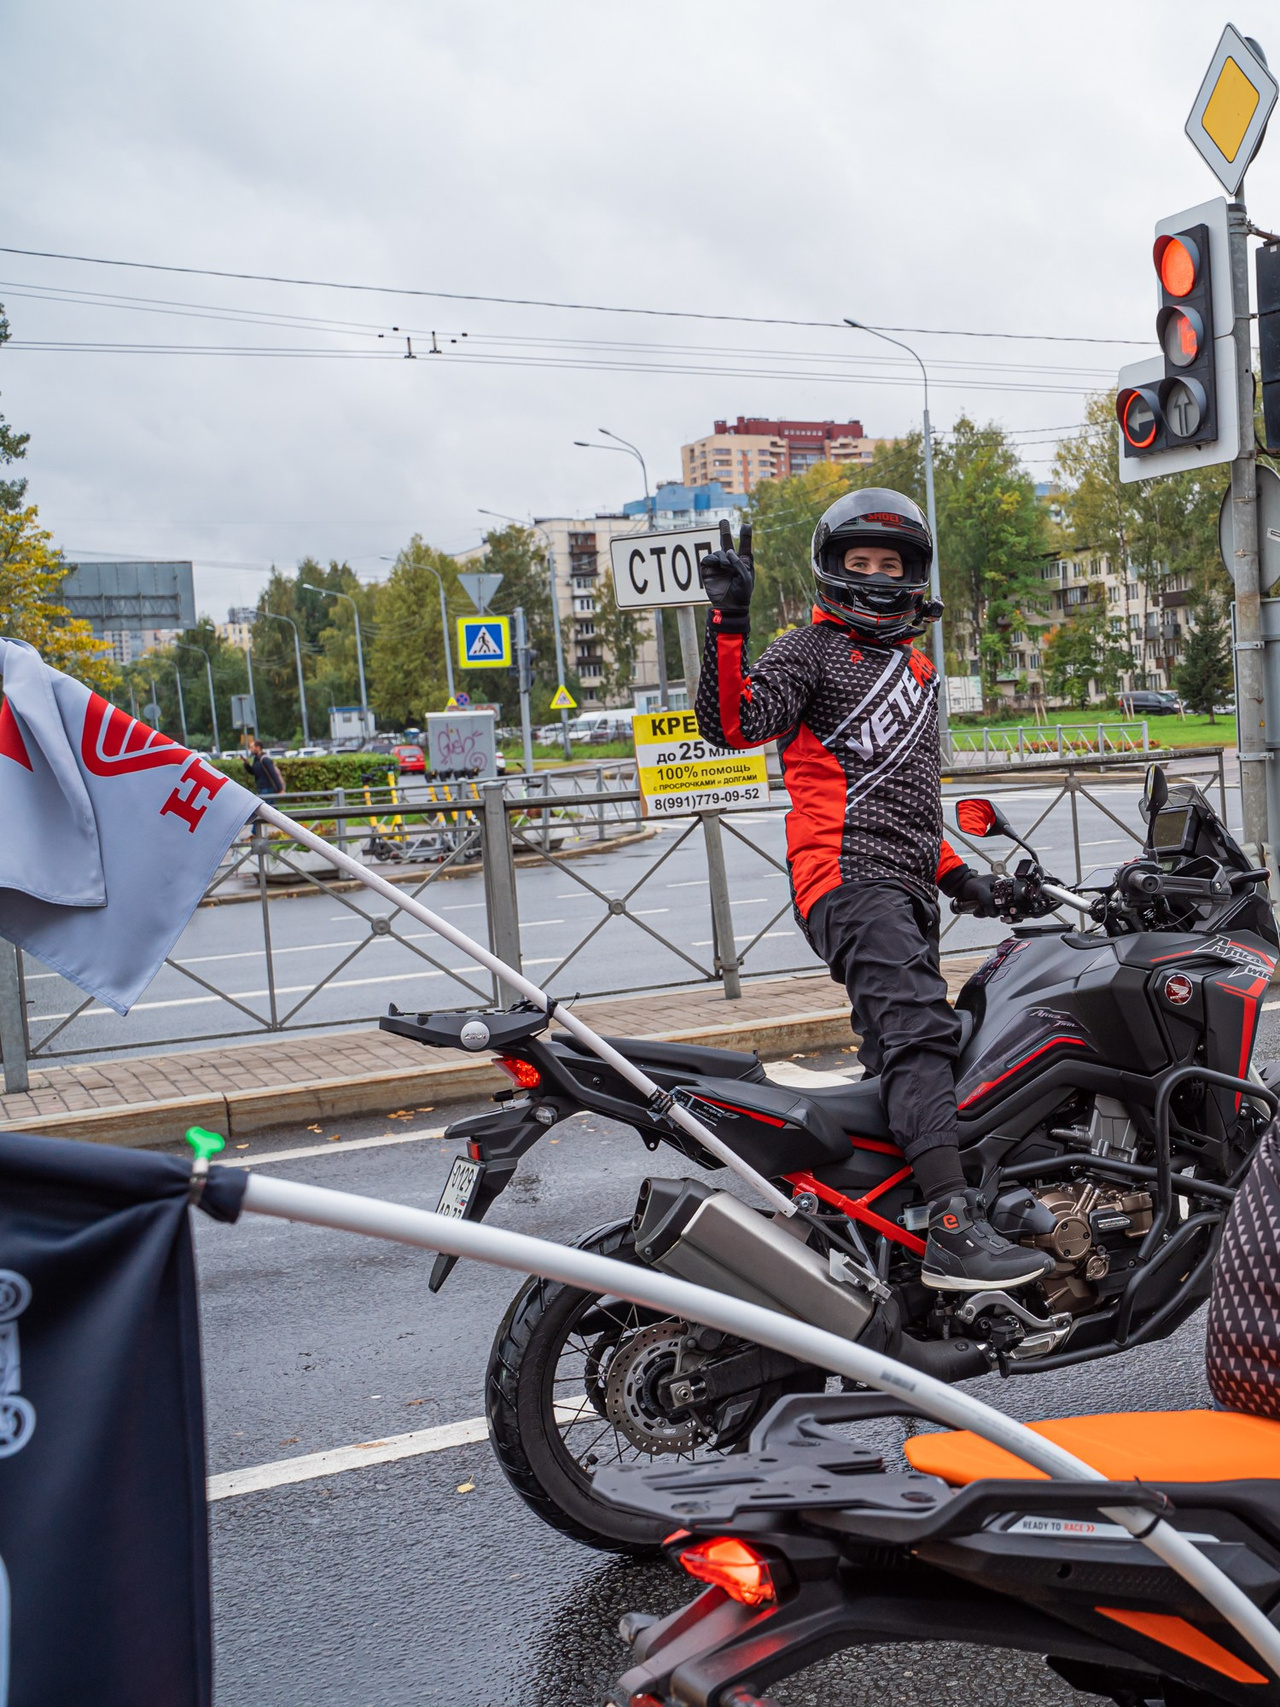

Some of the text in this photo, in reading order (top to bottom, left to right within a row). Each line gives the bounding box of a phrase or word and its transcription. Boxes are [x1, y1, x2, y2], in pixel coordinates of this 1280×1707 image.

[868, 513, 899, 523] SHOEI
[629, 542, 712, 595] СТОП
[651, 715, 700, 736] КРЕ
[657, 752, 676, 765] до
[679, 741, 705, 760] 25
[657, 765, 698, 781] 100%
[659, 779, 716, 791] ПРОСРОЧКАМИ
[723, 774, 758, 785] ДОЛГАМИ
[655, 788, 760, 811] 8(991)779-09-52
[1022, 1521, 1084, 1532] READY TO RACE
